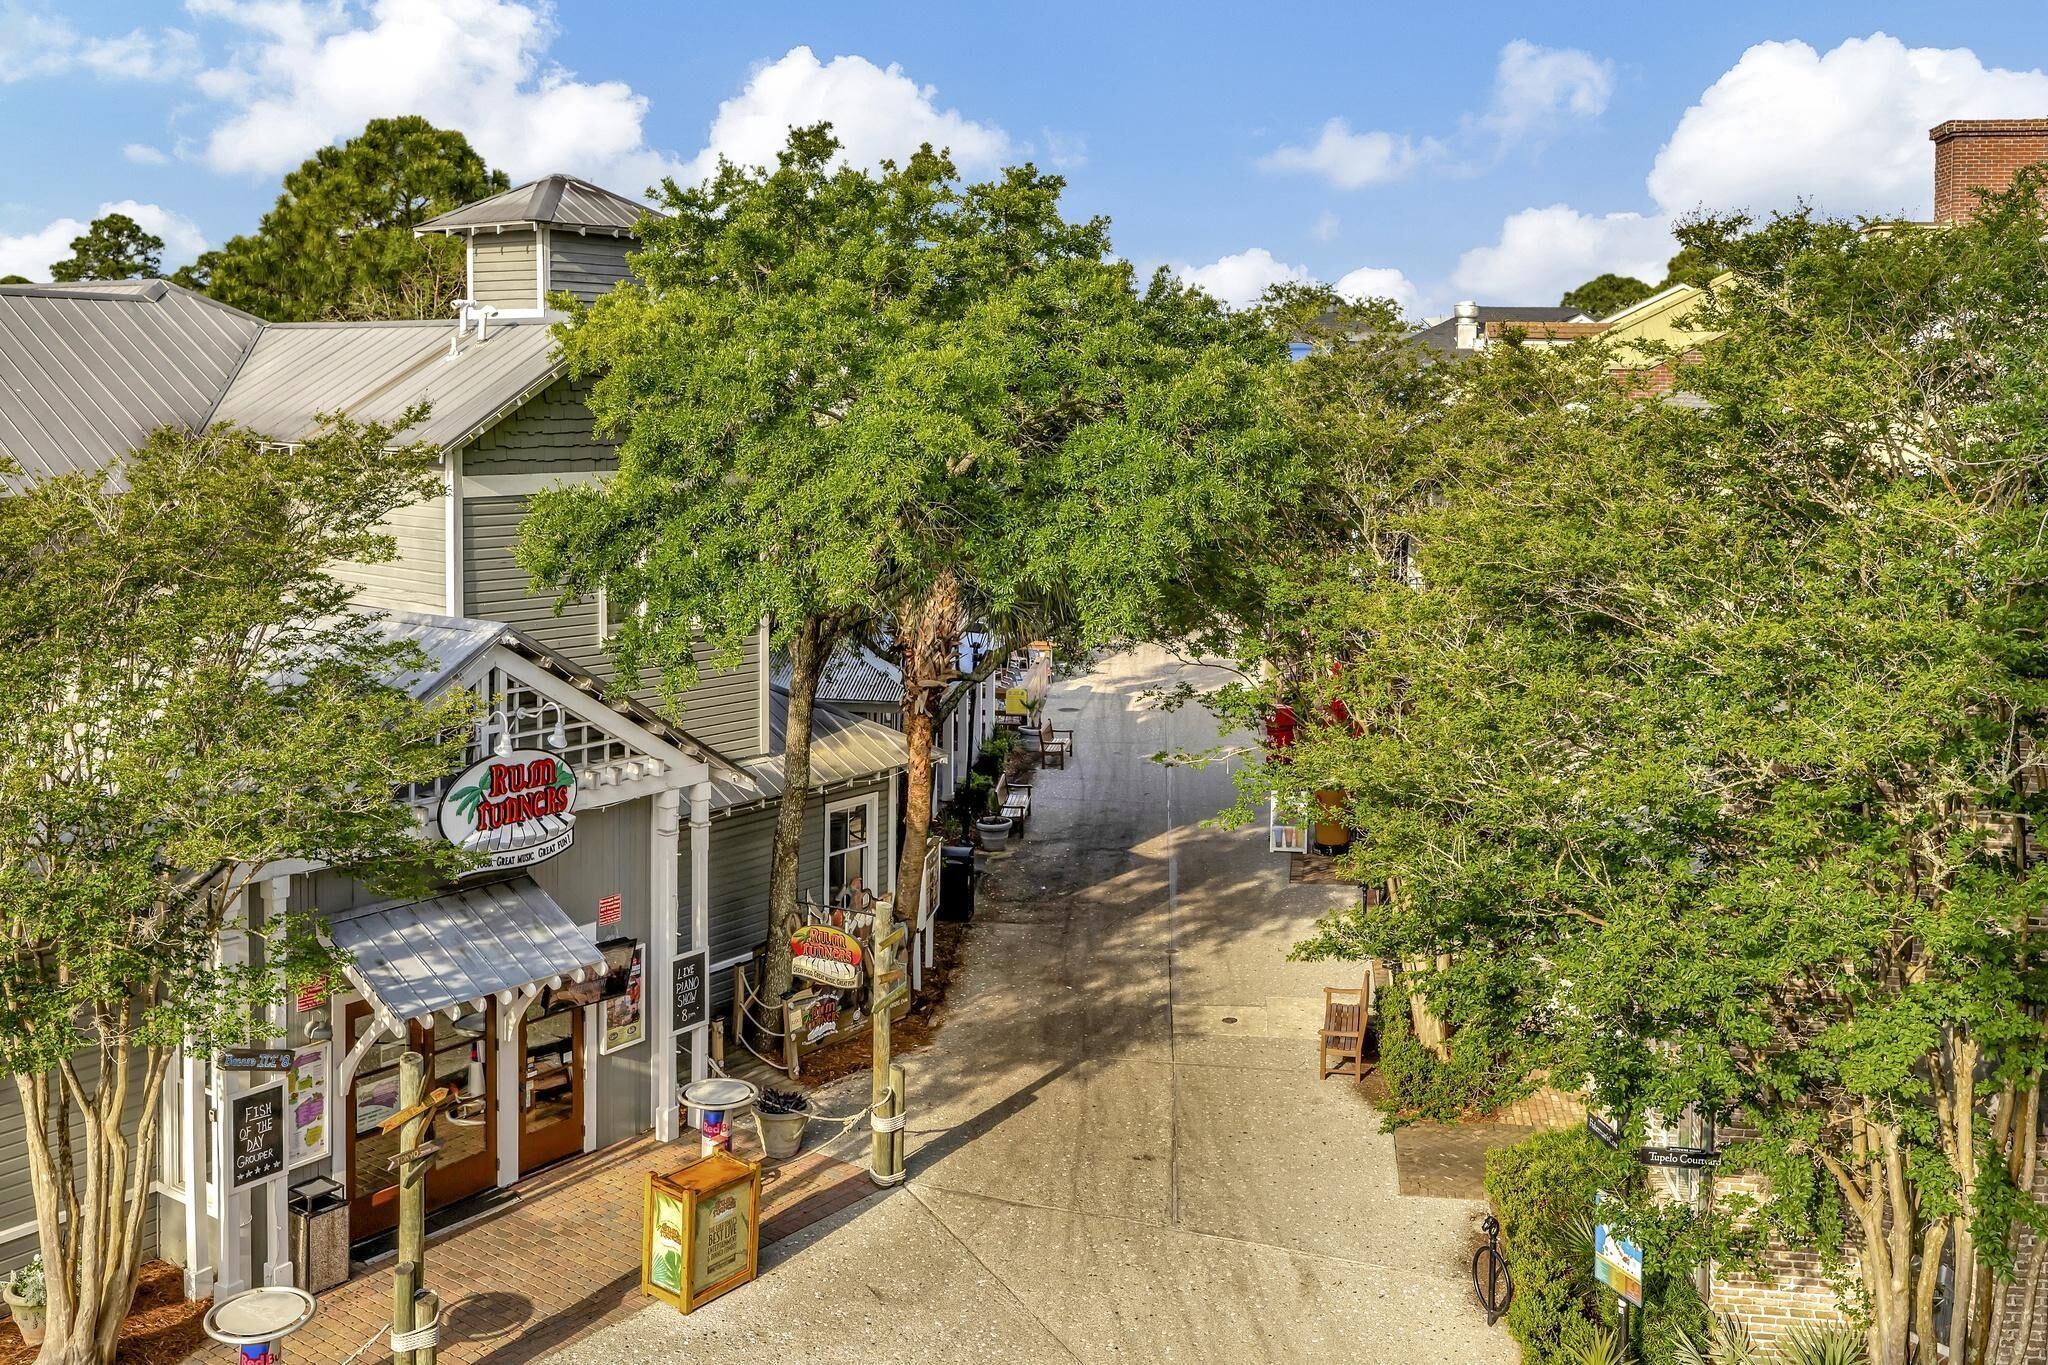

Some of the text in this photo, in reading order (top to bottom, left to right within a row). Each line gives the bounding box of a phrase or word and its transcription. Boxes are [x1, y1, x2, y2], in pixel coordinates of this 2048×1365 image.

[496, 856, 515, 866] GREAT
[538, 846, 556, 857] GREAT
[677, 964, 695, 980] LIVE
[676, 976, 699, 994] PIANO
[677, 990, 697, 1008] SHOW
[682, 1009, 688, 1021] 8
[245, 1102, 272, 1122] FISH
[239, 1117, 273, 1141] OF THE
[703, 1121, 720, 1134] Red
[246, 1134, 265, 1153] DAY
[236, 1148, 273, 1169] GROUPER
[396, 1150, 419, 1164] TOKYO
[1648, 1151, 1678, 1165] Tupelo
[708, 1223, 737, 1246] BEST LIVE
[241, 1352, 267, 1365] Red
